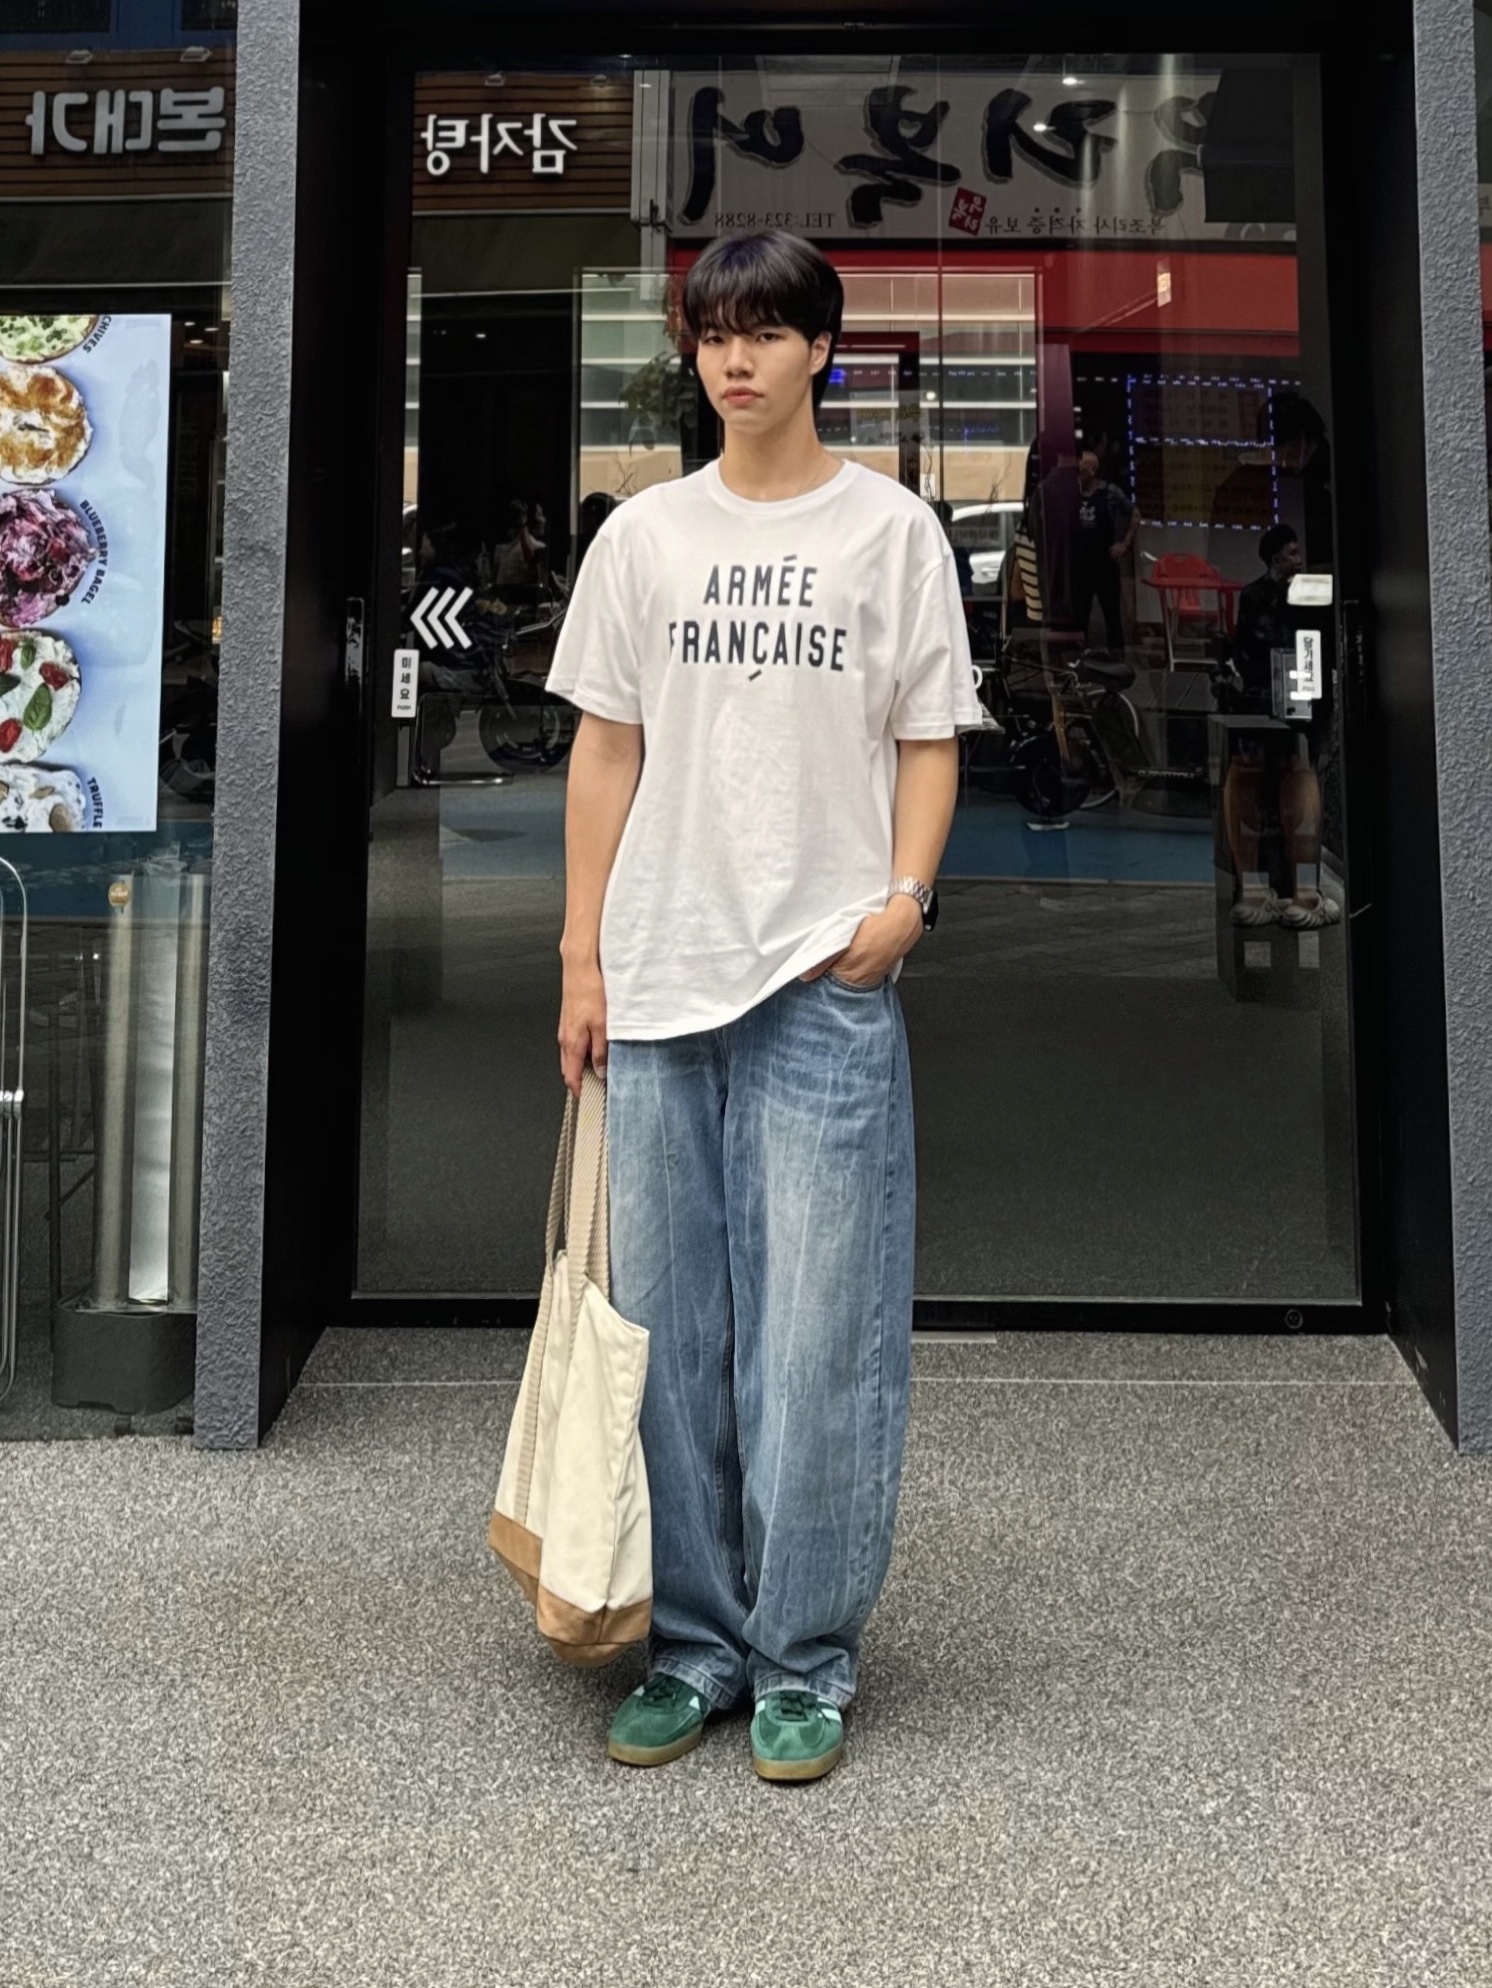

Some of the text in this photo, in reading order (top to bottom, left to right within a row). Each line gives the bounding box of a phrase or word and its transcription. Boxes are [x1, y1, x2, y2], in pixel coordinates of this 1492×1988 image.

[83, 315, 112, 353] CHIVES
[80, 499, 108, 604] BLUEBERRY BAGEL
[703, 554, 818, 607] ARMÉE
[400, 657, 412, 699] 미세요
[87, 776, 104, 829] TRUFFLE
